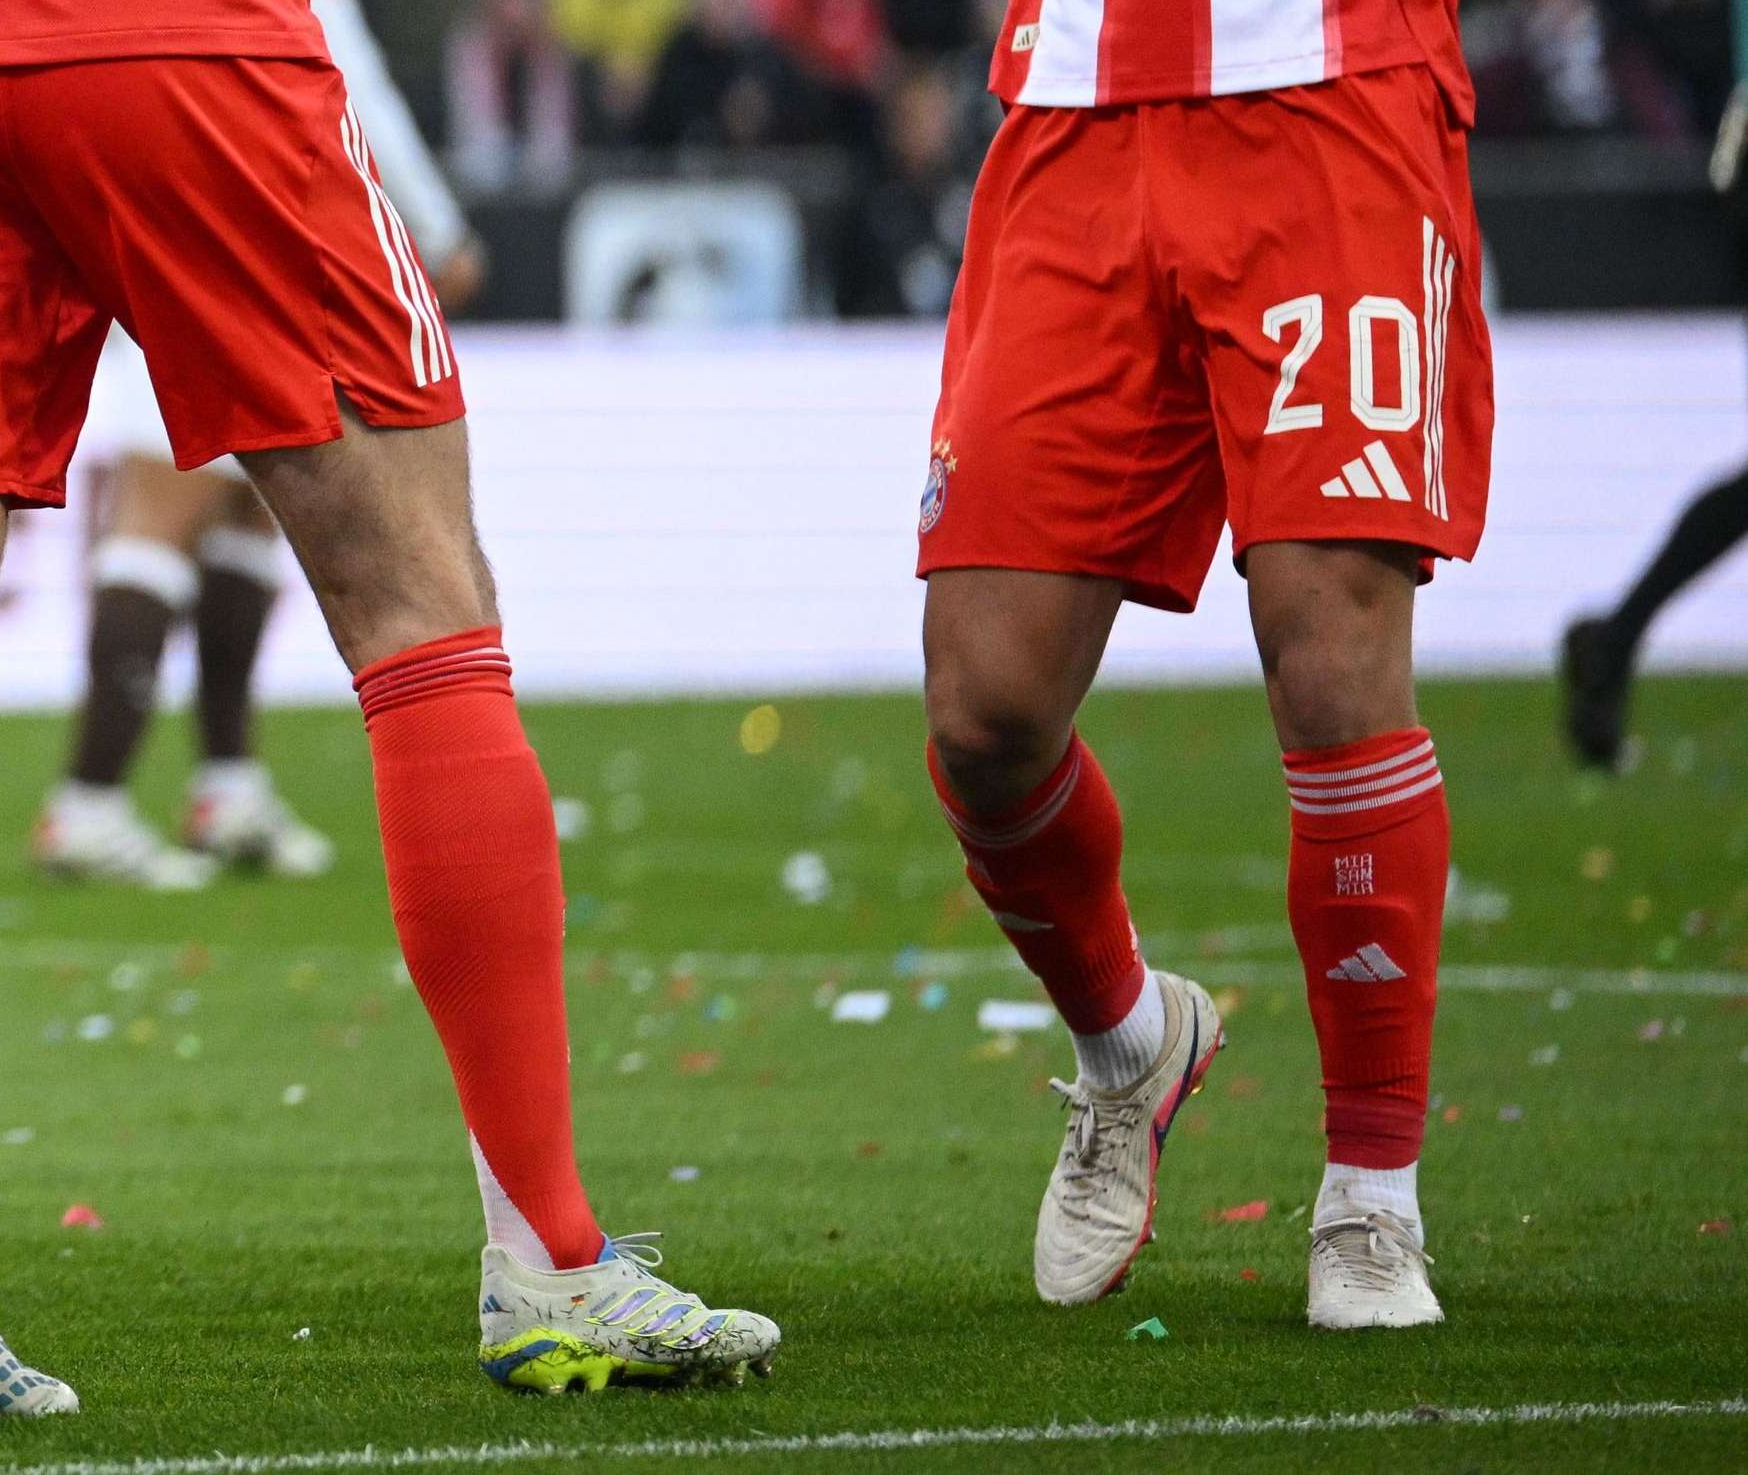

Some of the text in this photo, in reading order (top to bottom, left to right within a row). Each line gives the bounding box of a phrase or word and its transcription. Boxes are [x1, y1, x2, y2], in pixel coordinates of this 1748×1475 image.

[1262, 293, 1421, 436] 20
[1335, 853, 1373, 870] MIA
[1336, 881, 1374, 895] MIA
